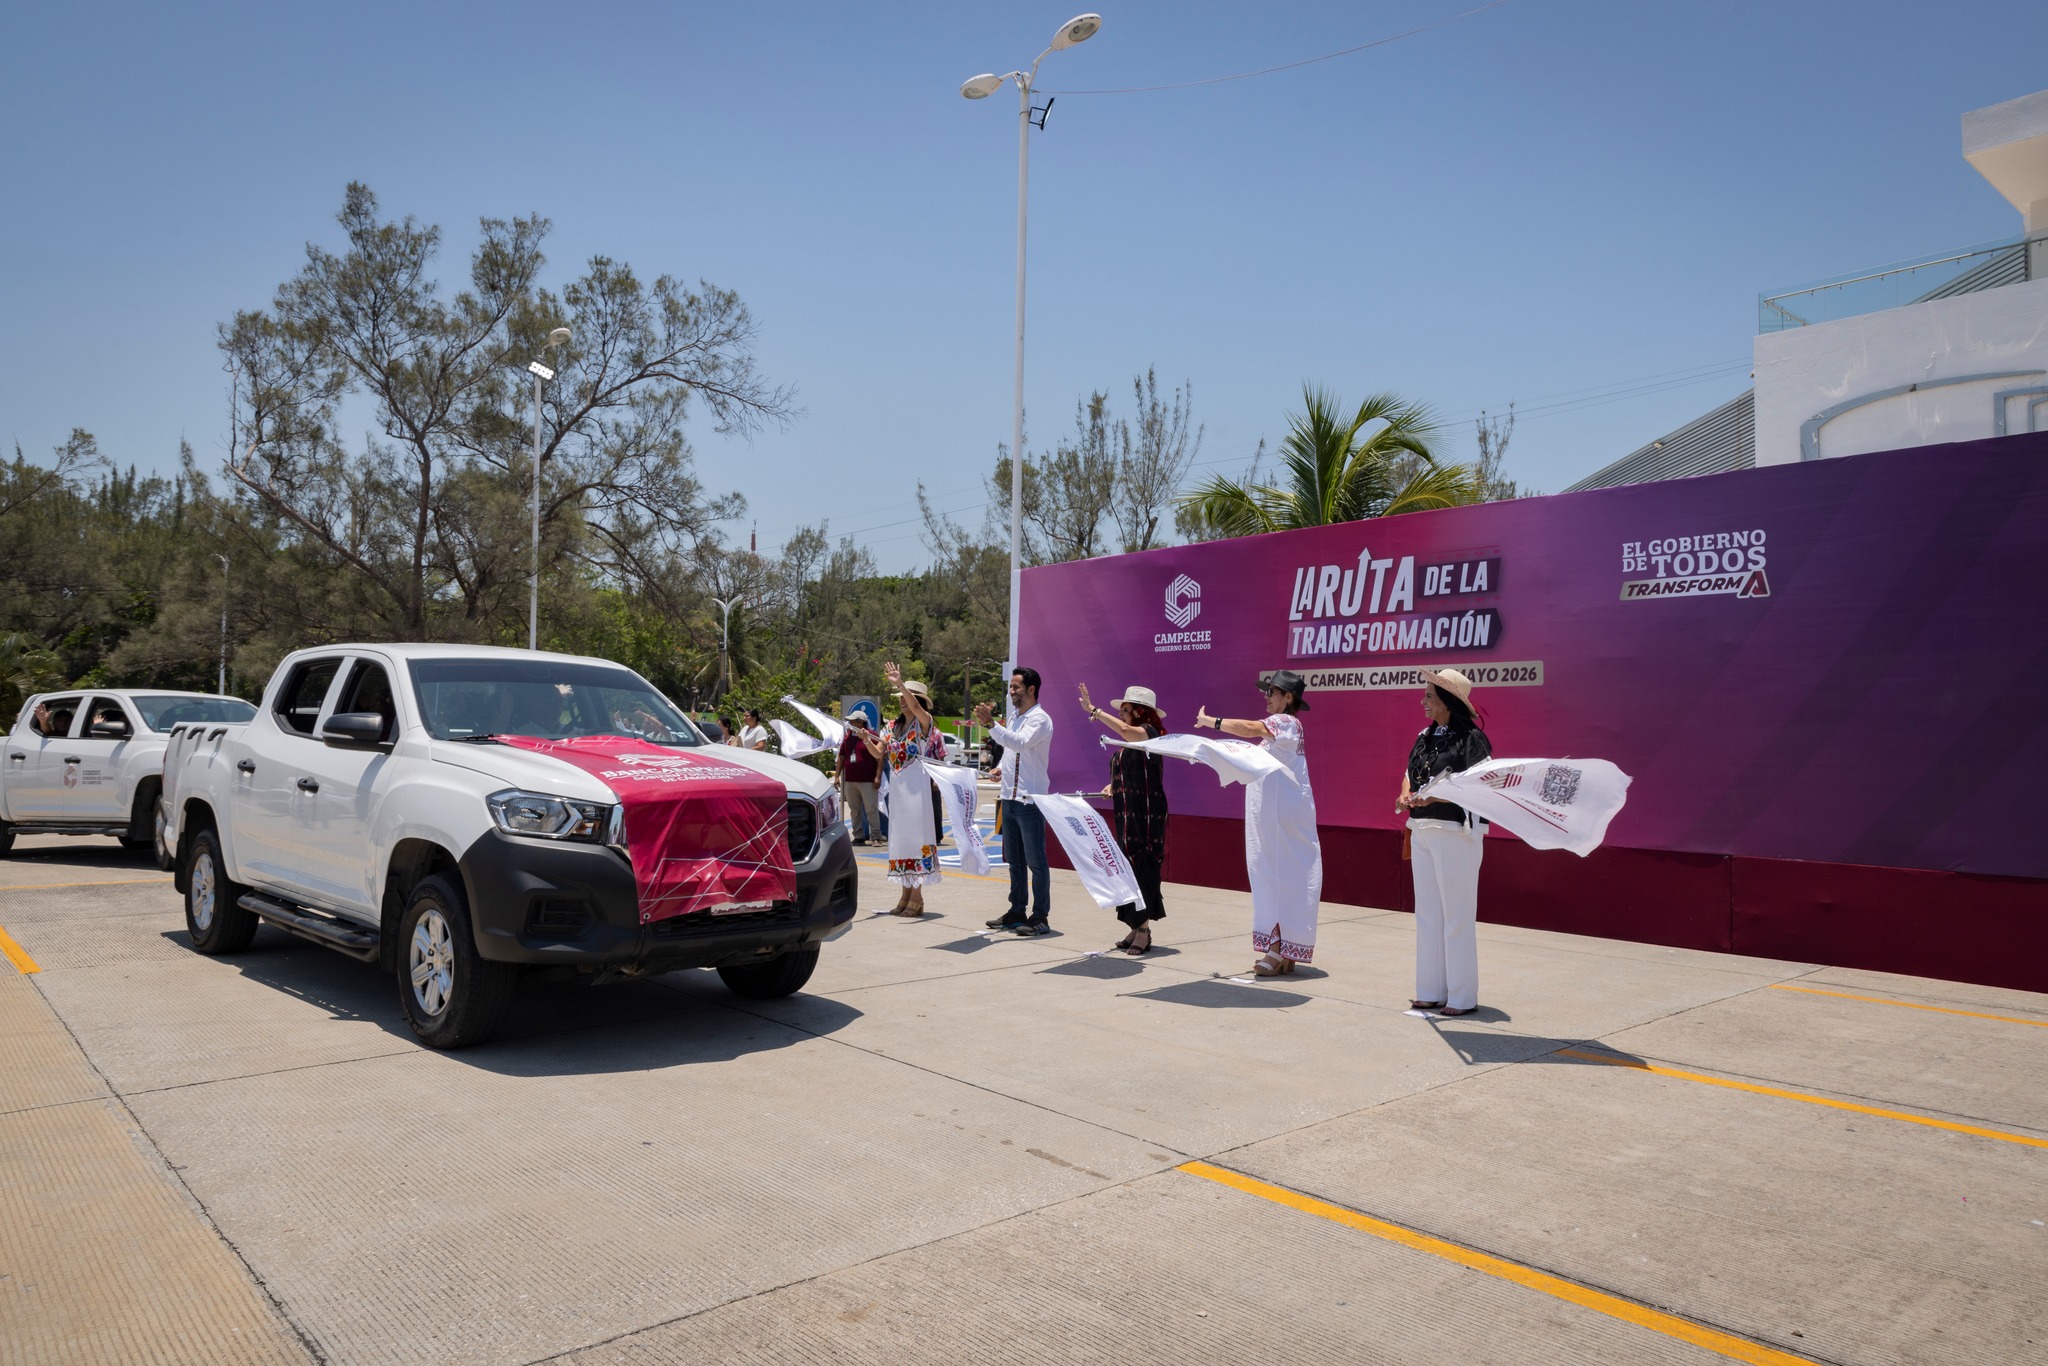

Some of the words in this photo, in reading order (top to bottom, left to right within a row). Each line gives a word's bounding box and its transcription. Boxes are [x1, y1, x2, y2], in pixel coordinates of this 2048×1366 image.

[1622, 542, 1646, 558] EL
[1648, 529, 1766, 556] GOBIERNO
[1622, 557, 1647, 572] DE
[1651, 546, 1766, 577] TODOS
[1289, 566, 1315, 620] LA
[1313, 547, 1414, 618] RUTA
[1423, 564, 1454, 596] DE
[1459, 560, 1488, 593] LA
[1627, 570, 1769, 597] TRANSFORMA
[1154, 630, 1211, 645] CAMPECHE
[1291, 610, 1491, 655] TRANSFORMACIÓN
[1154, 645, 1182, 653] GOBIERNO
[1310, 672, 1366, 688] CARMEN,
[1370, 669, 1441, 686] CAMPEC
[1501, 666, 1537, 682] 2026
